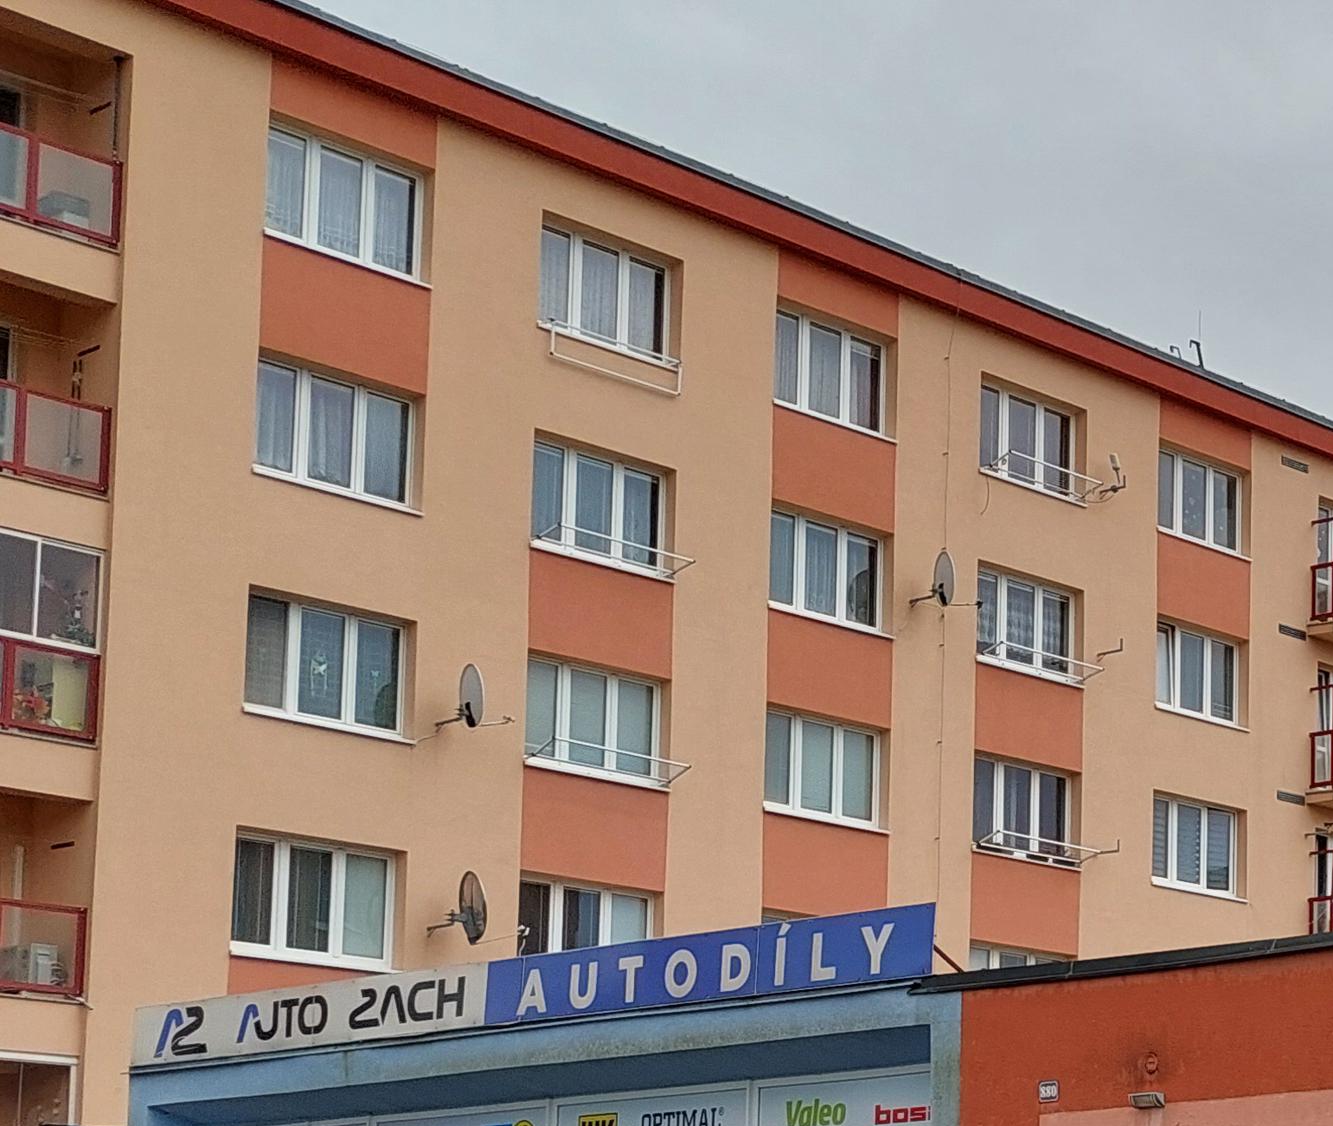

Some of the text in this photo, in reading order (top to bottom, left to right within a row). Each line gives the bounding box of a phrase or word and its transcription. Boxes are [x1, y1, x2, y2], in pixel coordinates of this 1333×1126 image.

[515, 922, 896, 1017] AUTODÍLY
[236, 975, 466, 1044] AUTO ZACH
[1040, 1085, 1057, 1098] 880
[874, 1104, 931, 1126] bos
